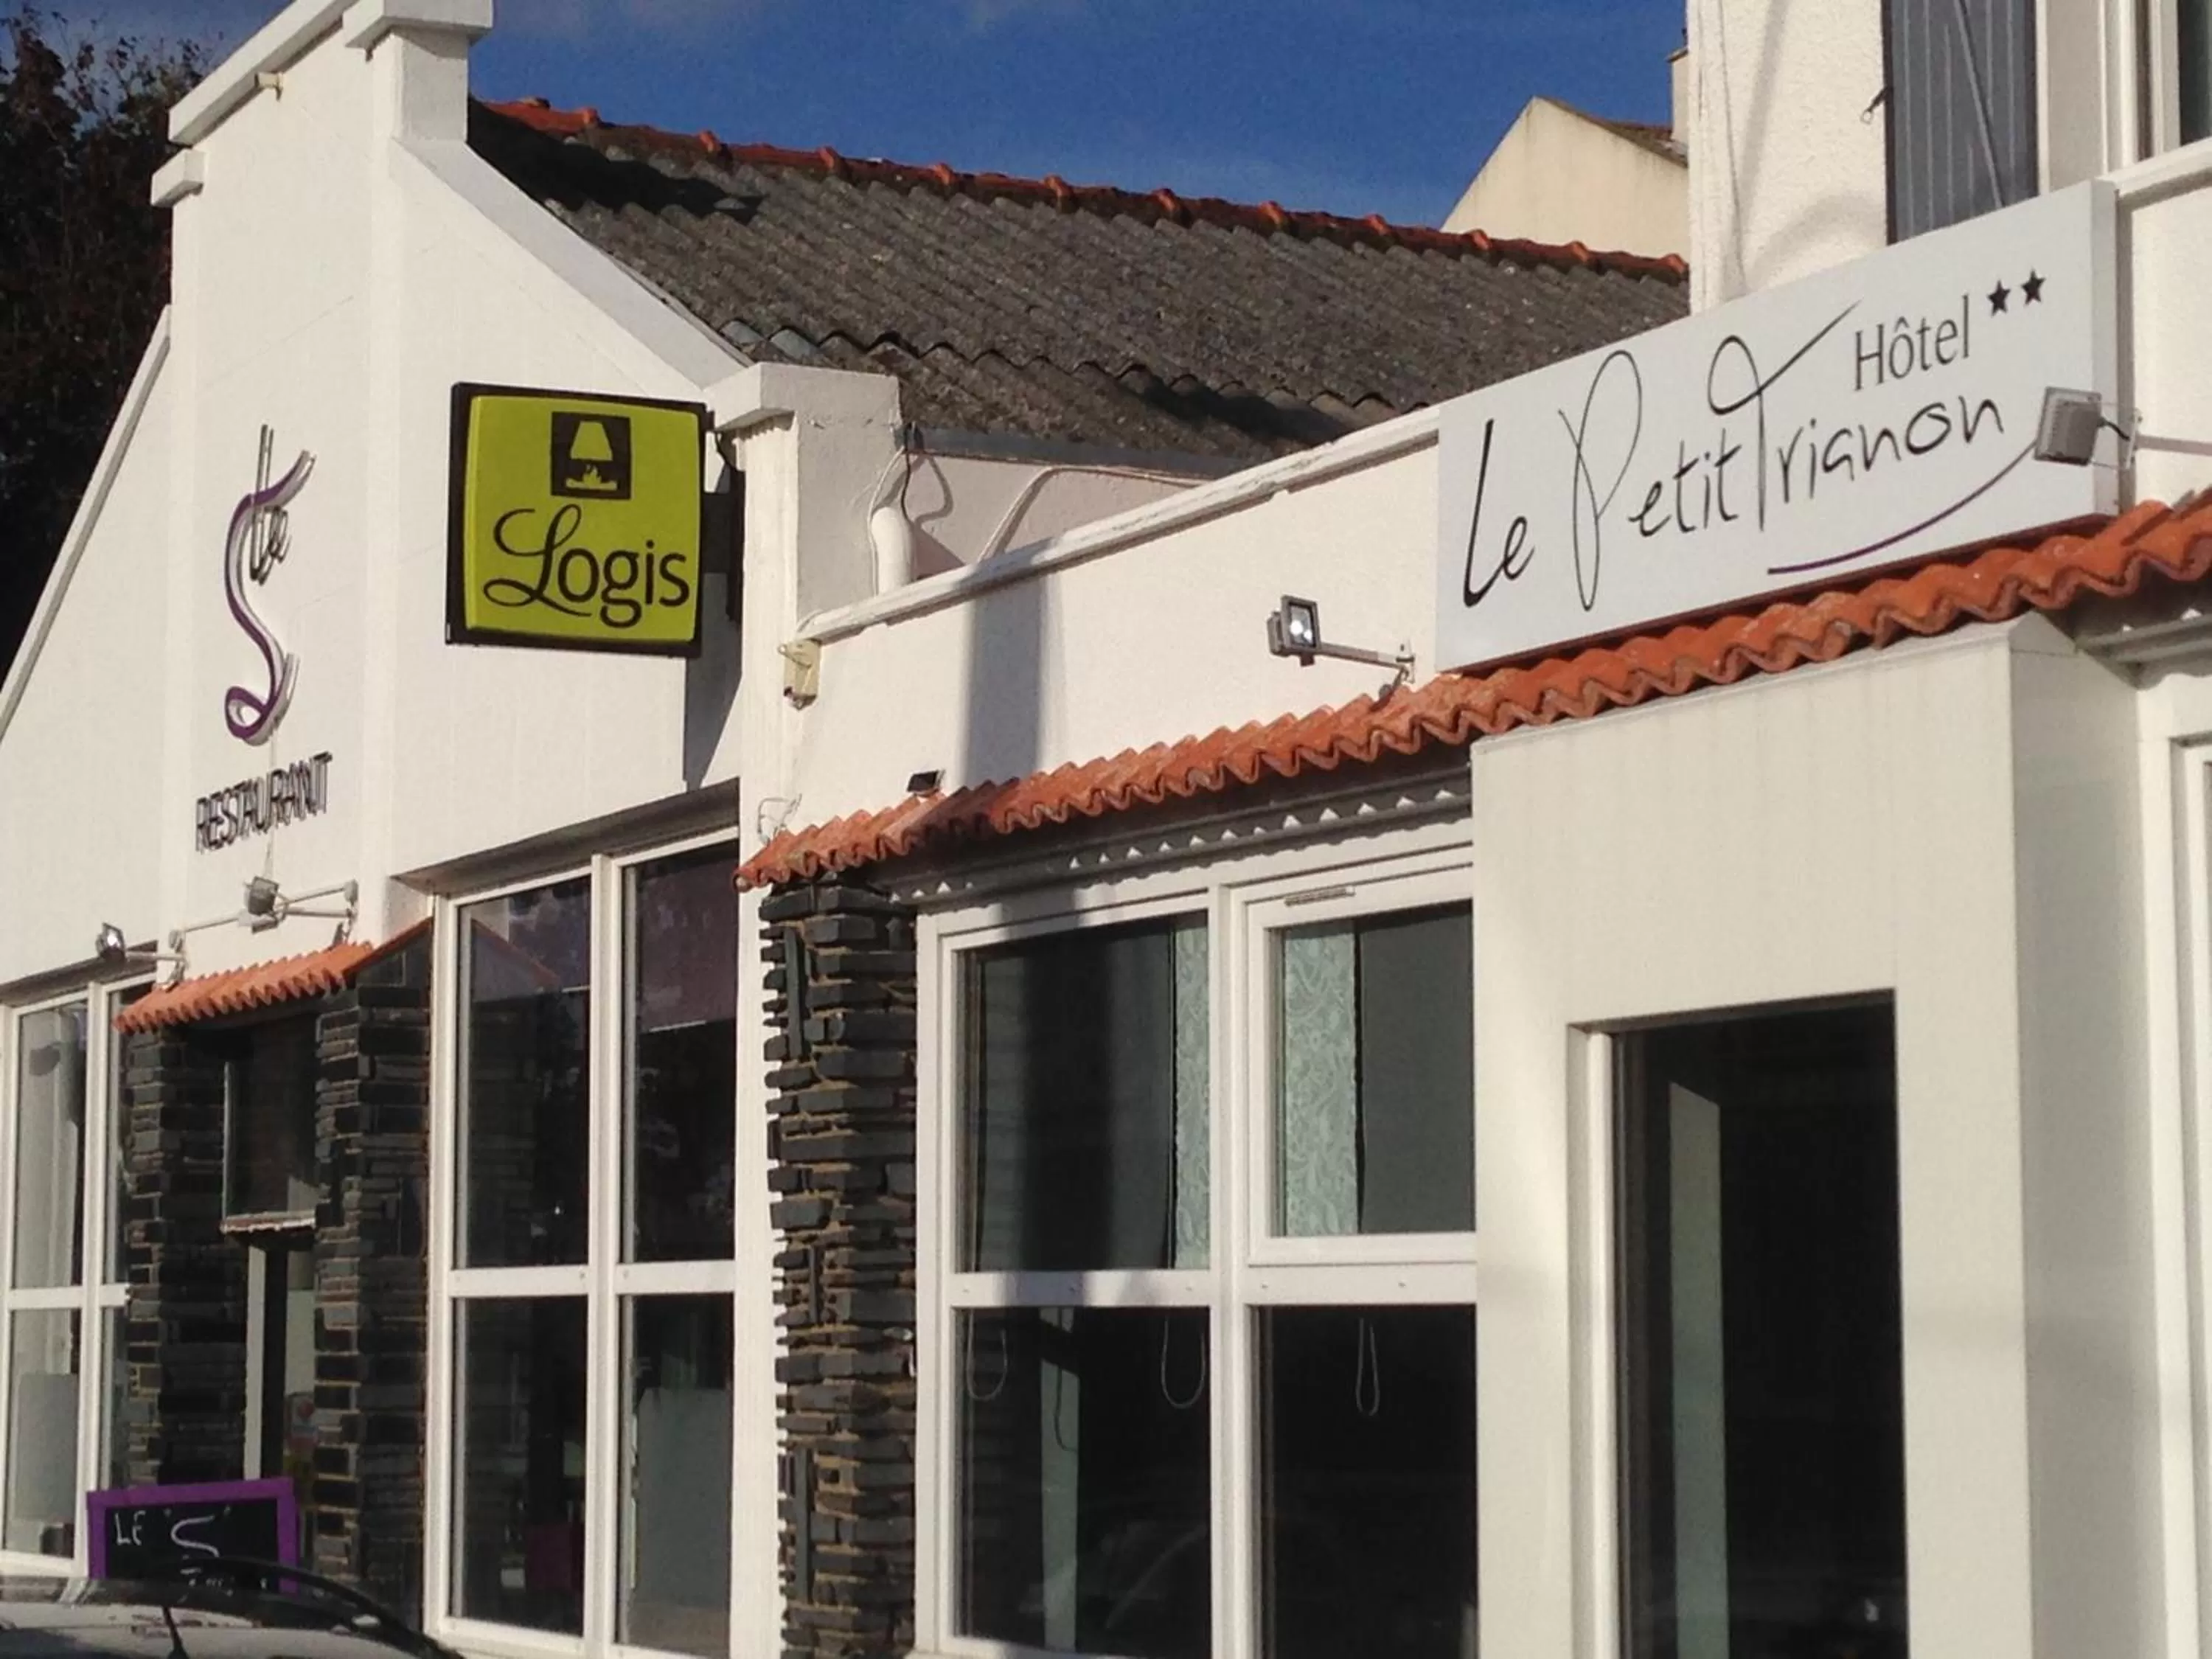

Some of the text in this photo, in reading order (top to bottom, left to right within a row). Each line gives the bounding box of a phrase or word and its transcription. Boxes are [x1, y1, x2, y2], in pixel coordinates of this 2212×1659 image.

[1854, 294, 1971, 391] Hôtel
[1463, 299, 2004, 612] Le Petit Trianon
[483, 503, 690, 628] Logis
[195, 751, 333, 854] RESTAURANT
